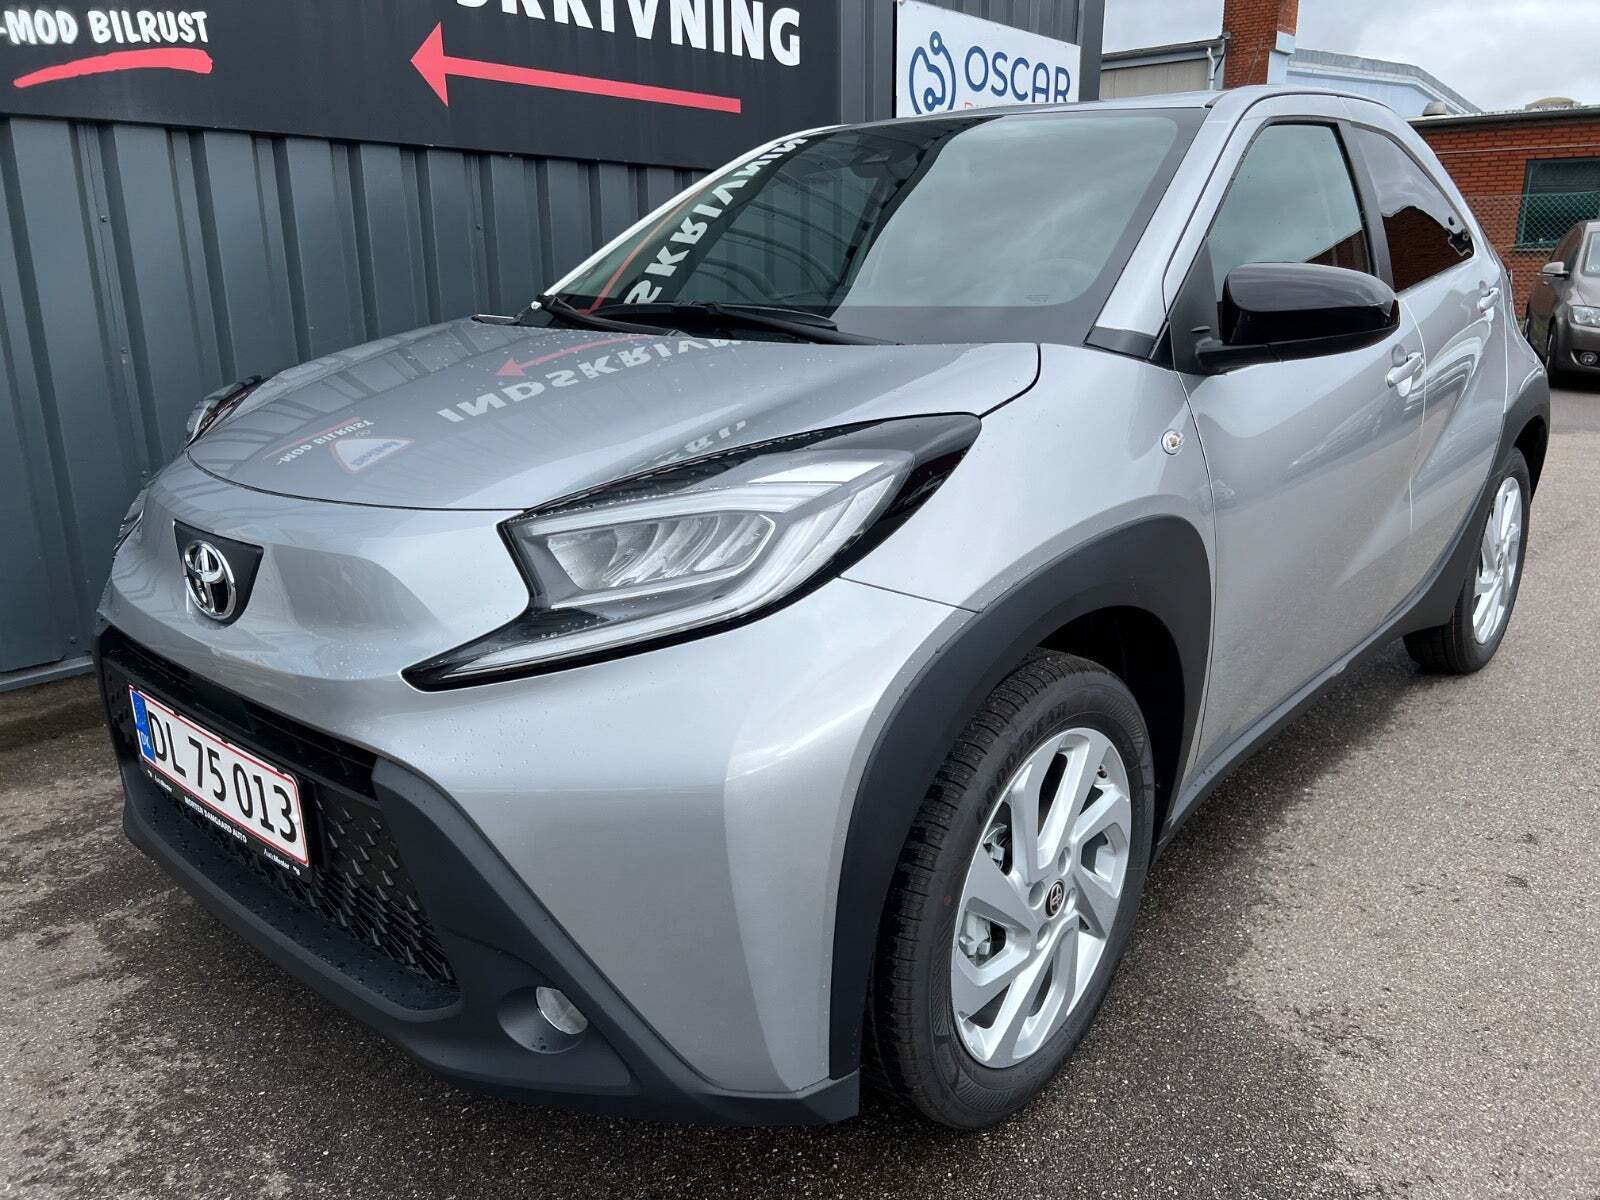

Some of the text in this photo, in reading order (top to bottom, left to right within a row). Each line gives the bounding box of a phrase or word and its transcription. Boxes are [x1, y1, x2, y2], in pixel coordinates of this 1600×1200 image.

[0, 9, 209, 45] -MOD BILRUST
[456, 0, 800, 67] IVNING
[964, 45, 1071, 103] OSCAR
[147, 709, 298, 843] DL 75 013
